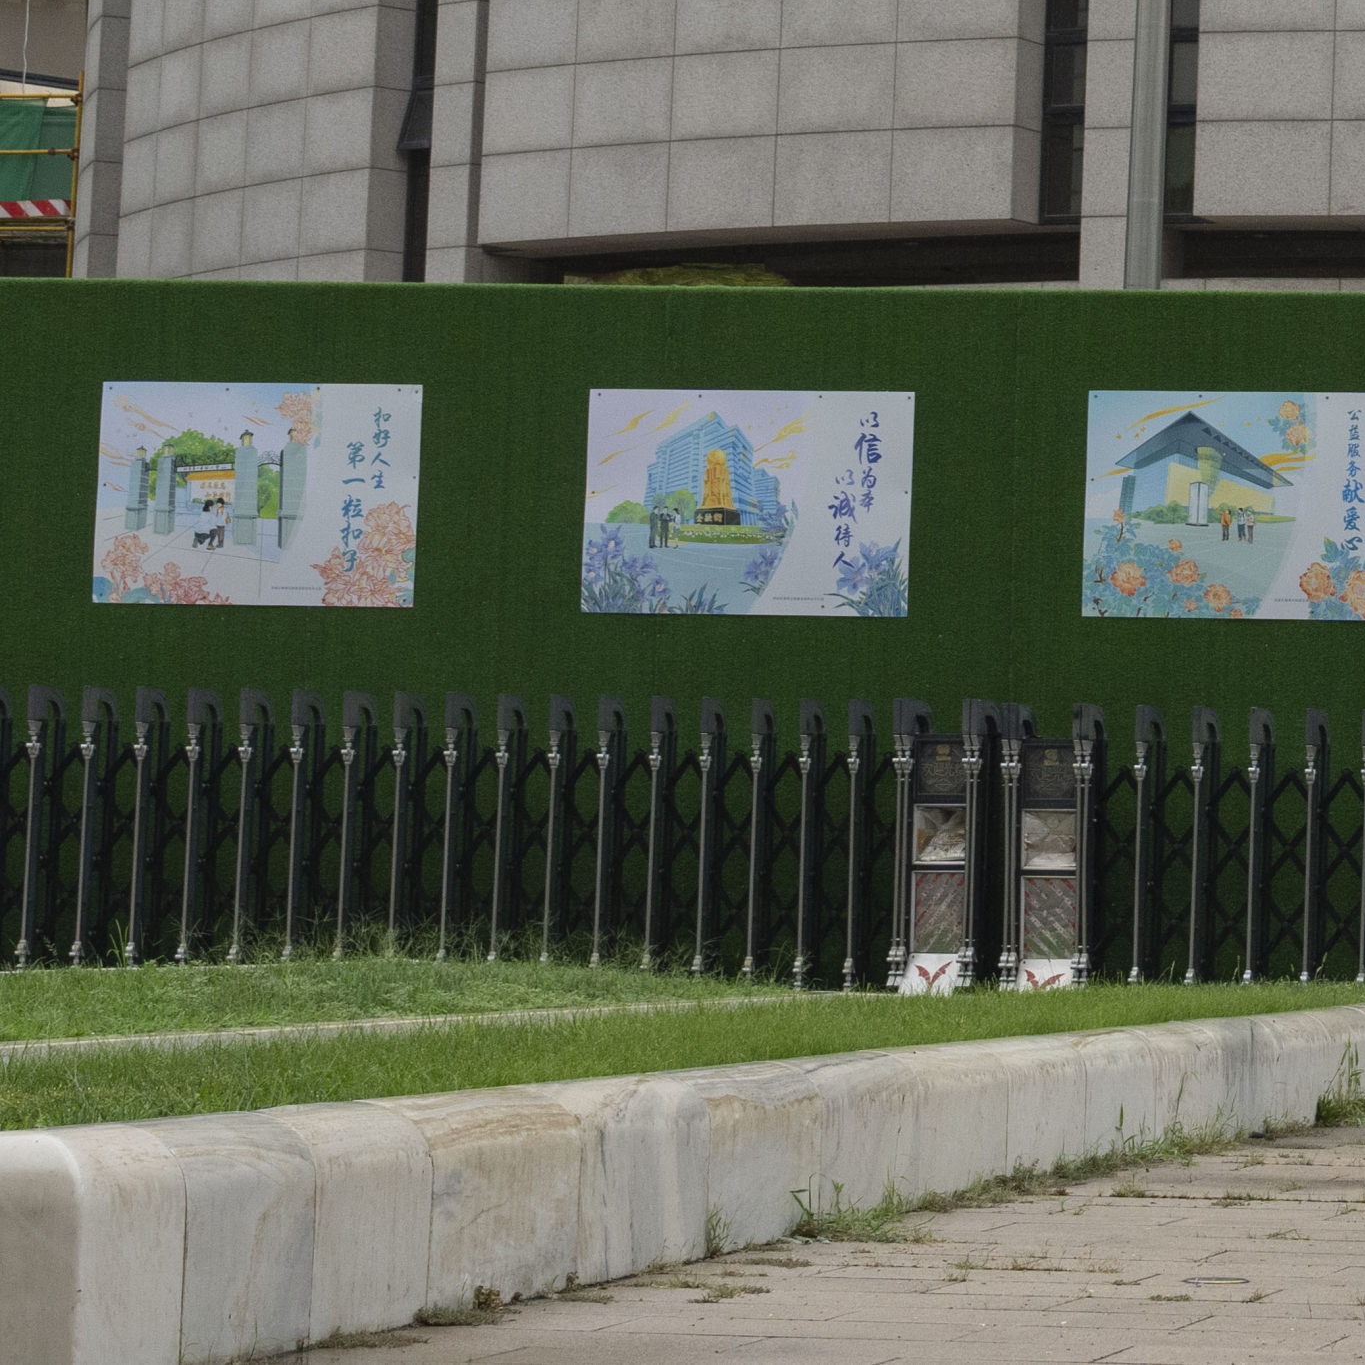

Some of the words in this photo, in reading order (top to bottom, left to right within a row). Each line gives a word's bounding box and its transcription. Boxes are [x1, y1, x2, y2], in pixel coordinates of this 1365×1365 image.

[369, 406, 392, 490] 扣好人生
[854, 410, 883, 513] 以信为本
[1341, 409, 1365, 552] 公益服务献爱心
[338, 441, 366, 573] 第一粒扣子
[828, 469, 857, 569] 以诚待人
